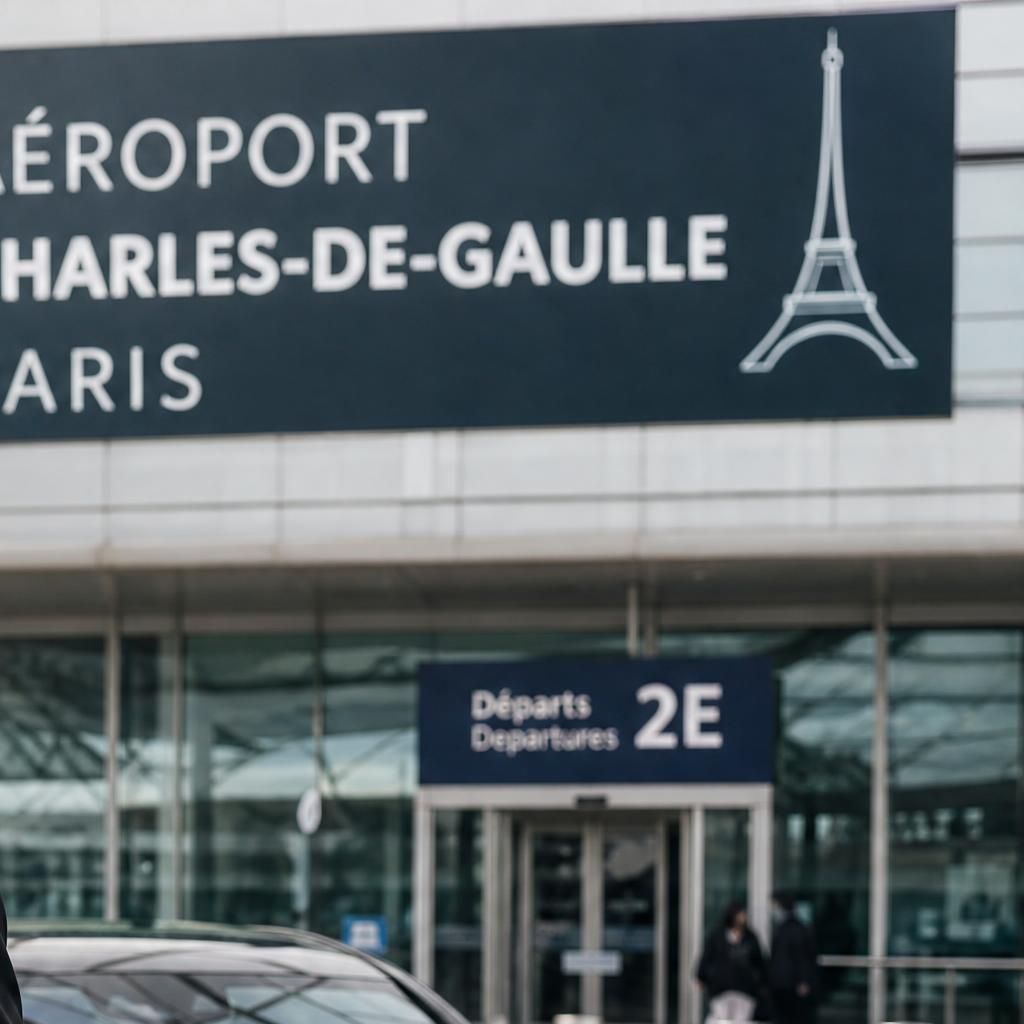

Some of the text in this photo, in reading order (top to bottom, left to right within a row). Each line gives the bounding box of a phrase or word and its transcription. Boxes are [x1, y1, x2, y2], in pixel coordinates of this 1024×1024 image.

[471, 687, 592, 725] Départs
[633, 682, 724, 749] 2E
[471, 723, 619, 756] Departures
